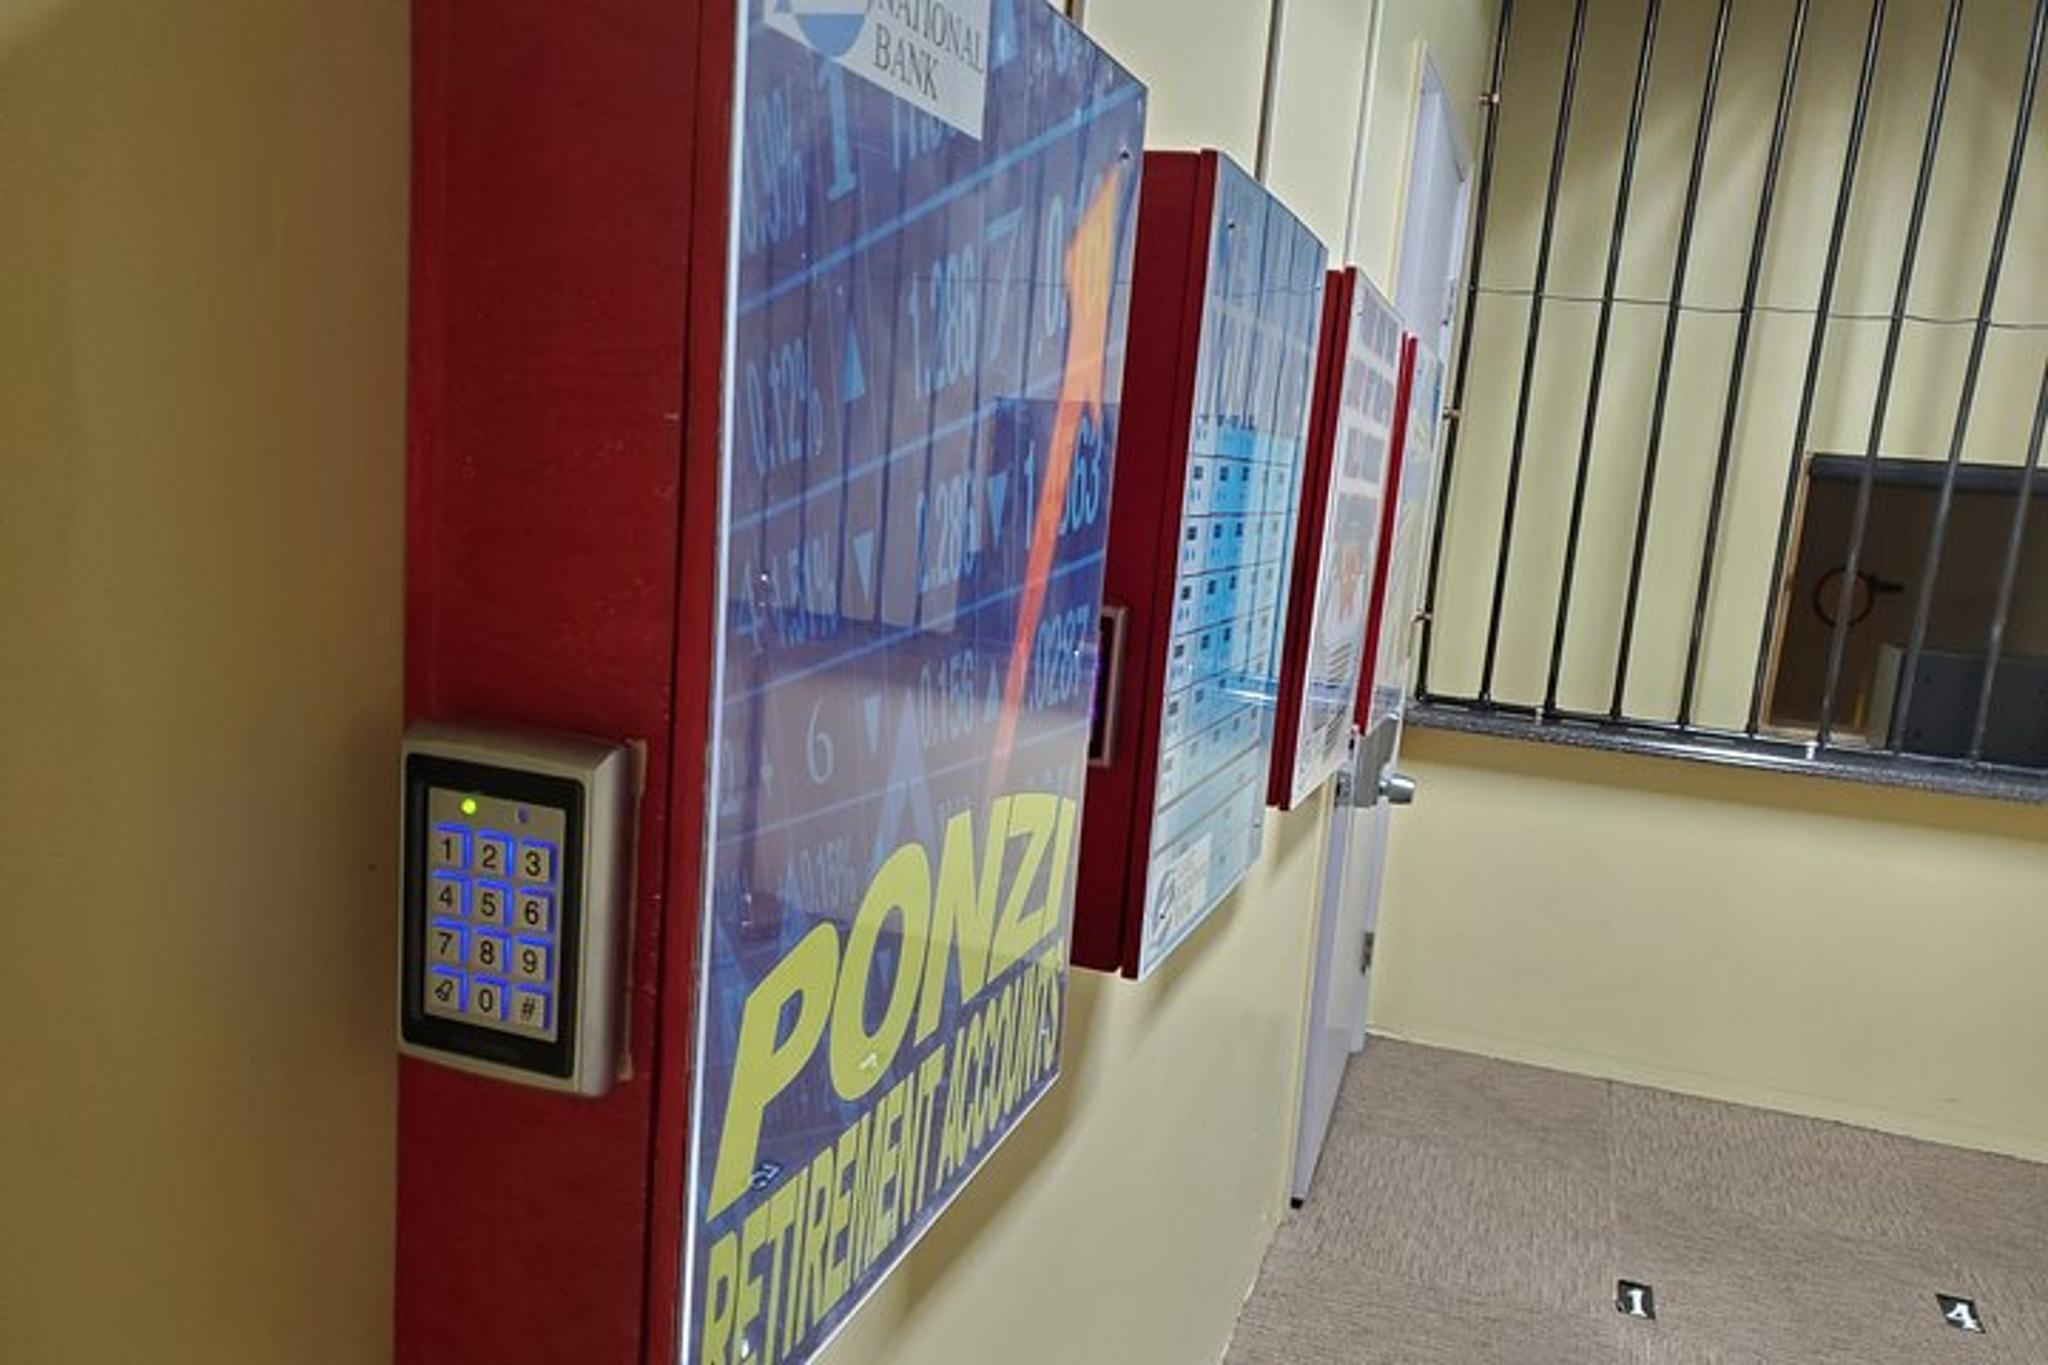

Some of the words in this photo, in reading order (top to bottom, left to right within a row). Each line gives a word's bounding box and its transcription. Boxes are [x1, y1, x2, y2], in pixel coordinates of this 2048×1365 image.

[874, 23, 937, 100] BANK
[806, 697, 834, 785] 6
[442, 839, 452, 861] 1
[482, 845, 497, 870] 2
[525, 851, 541, 877] 3
[438, 886, 453, 909] 4
[481, 892, 496, 917] 5
[523, 899, 539, 925] 6
[437, 932, 452, 956] 7
[480, 940, 495, 966] 8
[522, 949, 537, 975] 9
[479, 988, 494, 1013] 0
[521, 998, 536, 1020] #
[706, 793, 1076, 1222] PONZI
[702, 1044, 946, 1365] RETIREMENT
[934, 940, 1064, 1191] ACCOUNTS
[1627, 1288, 1648, 1318] 1
[1945, 1302, 1981, 1330] 4
